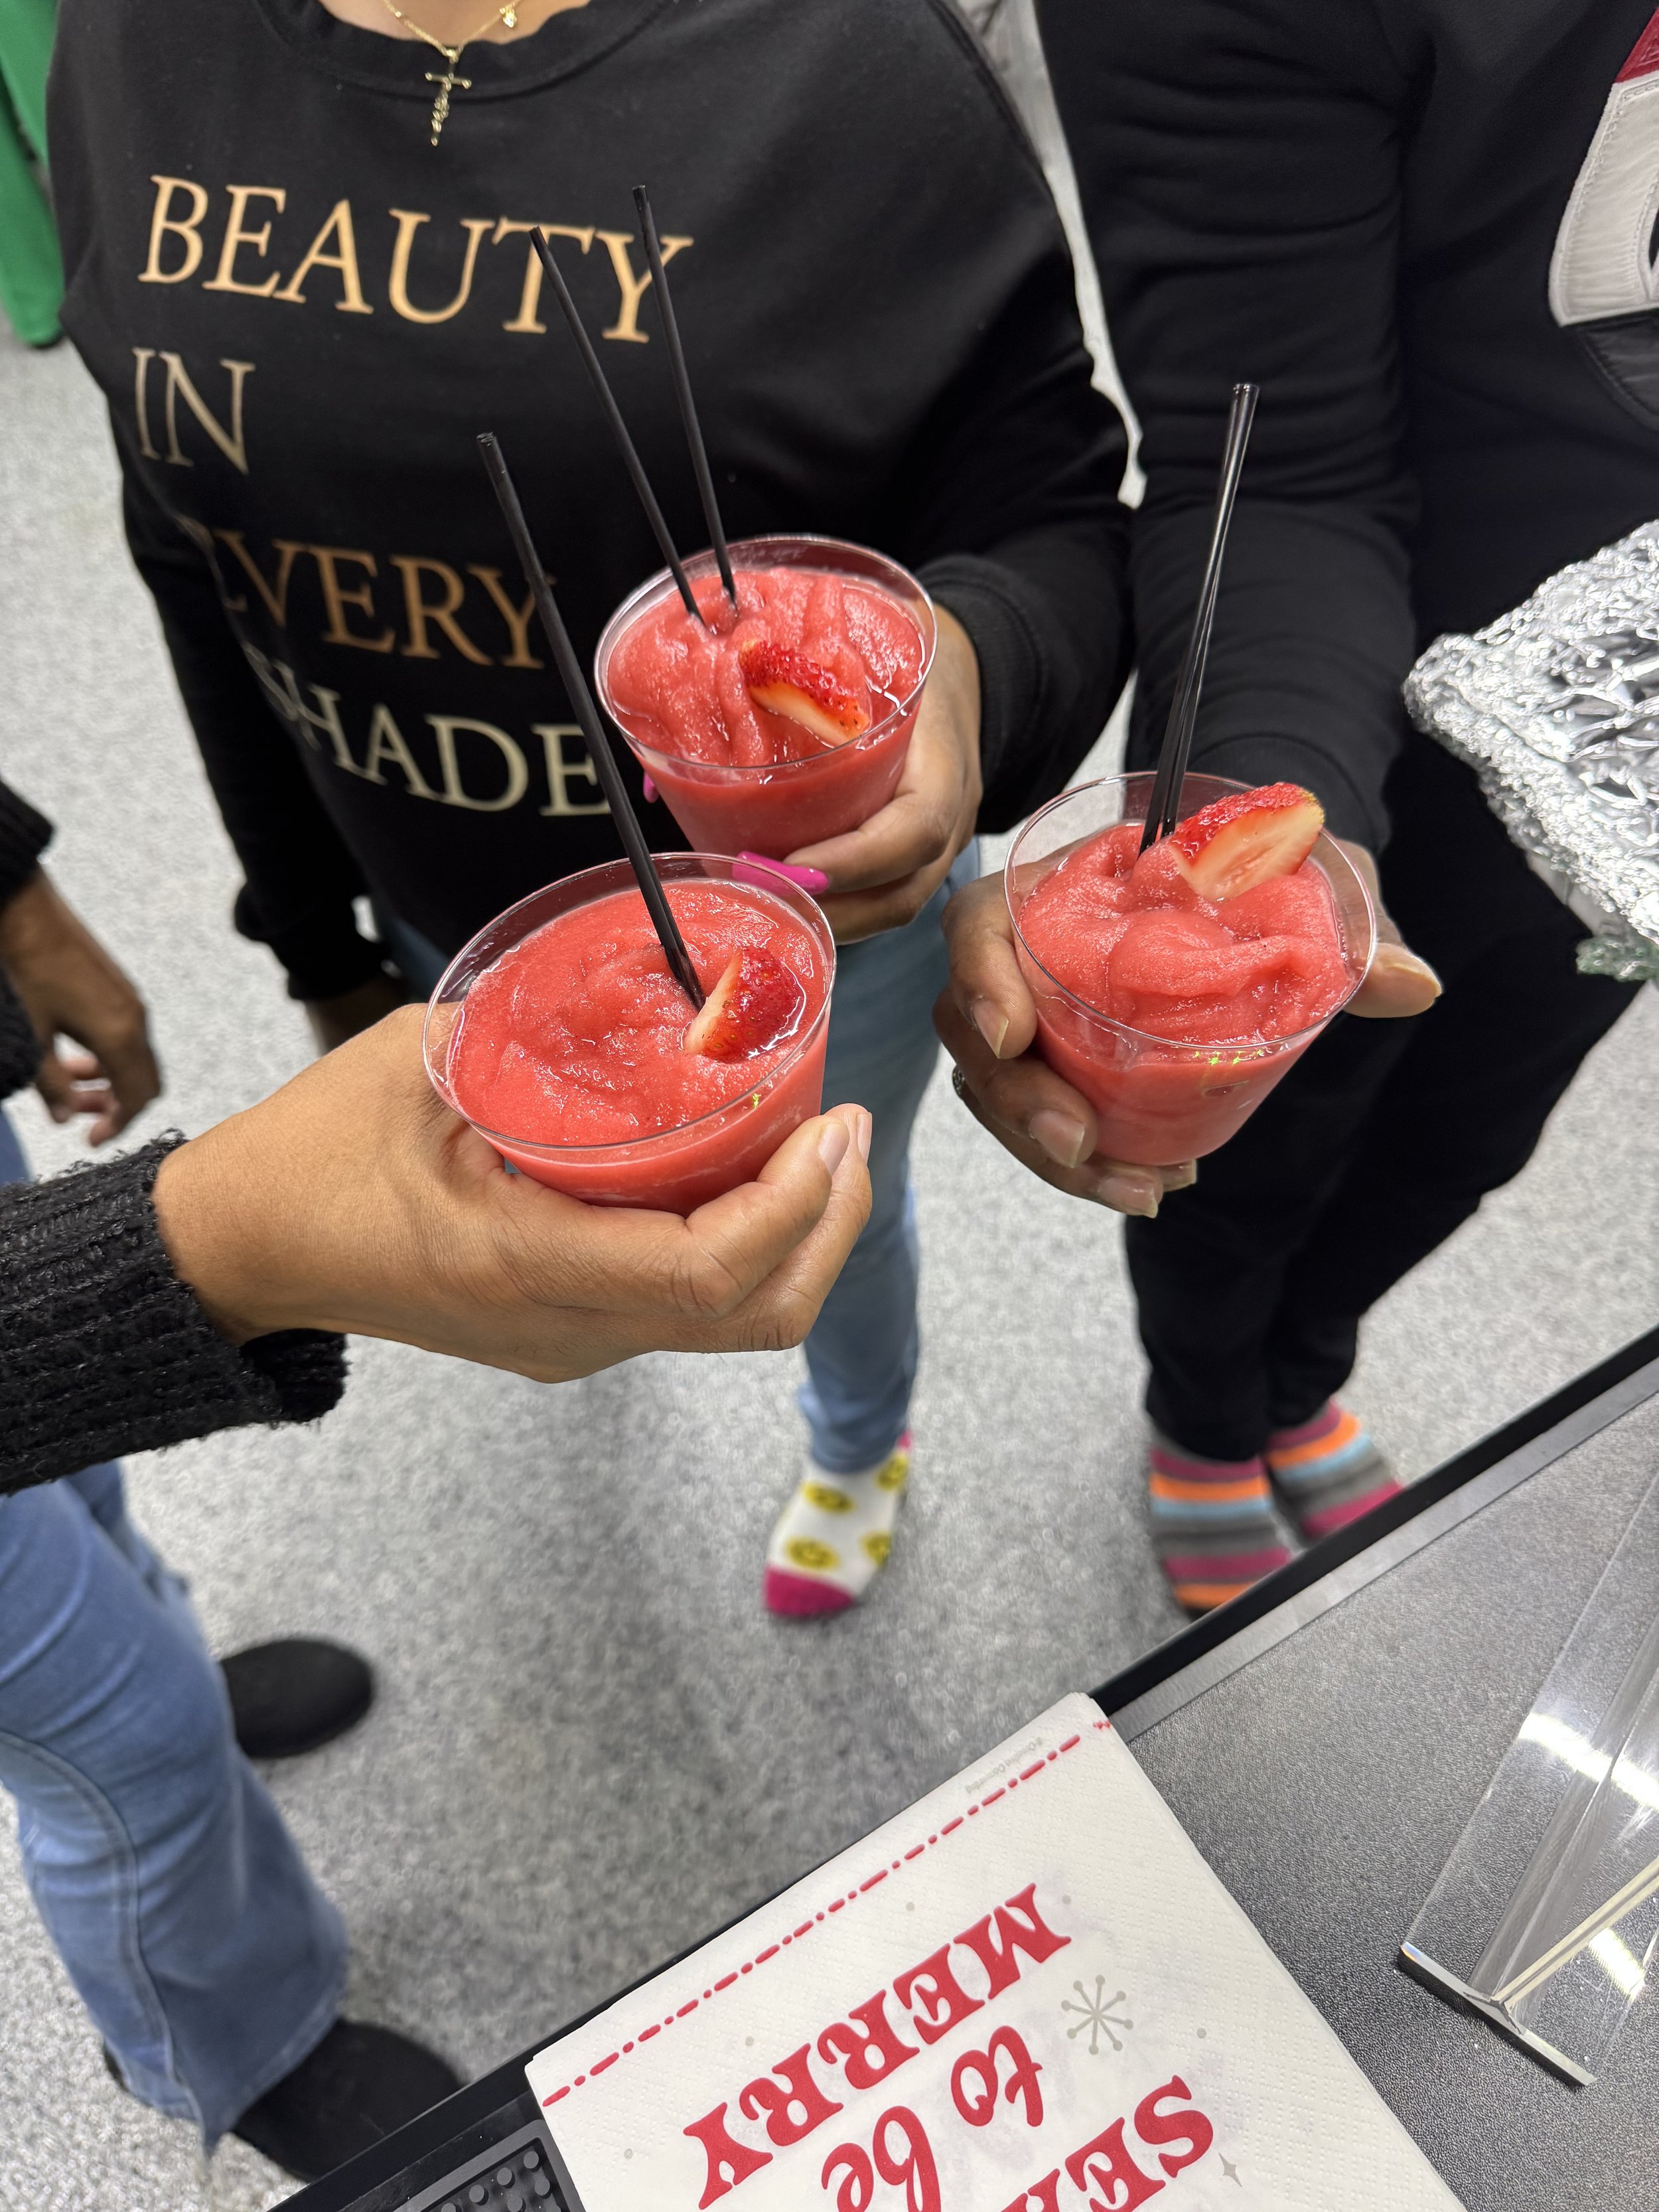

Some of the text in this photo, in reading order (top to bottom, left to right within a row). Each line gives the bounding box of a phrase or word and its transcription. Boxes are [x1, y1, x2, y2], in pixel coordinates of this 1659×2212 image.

[137, 174, 694, 344] BEAUTY
[131, 346, 255, 475] IN
[174, 514, 556, 670] VERY
[684, 1883, 1072, 2210] MERRY
[821, 2026, 1044, 2212] to be
